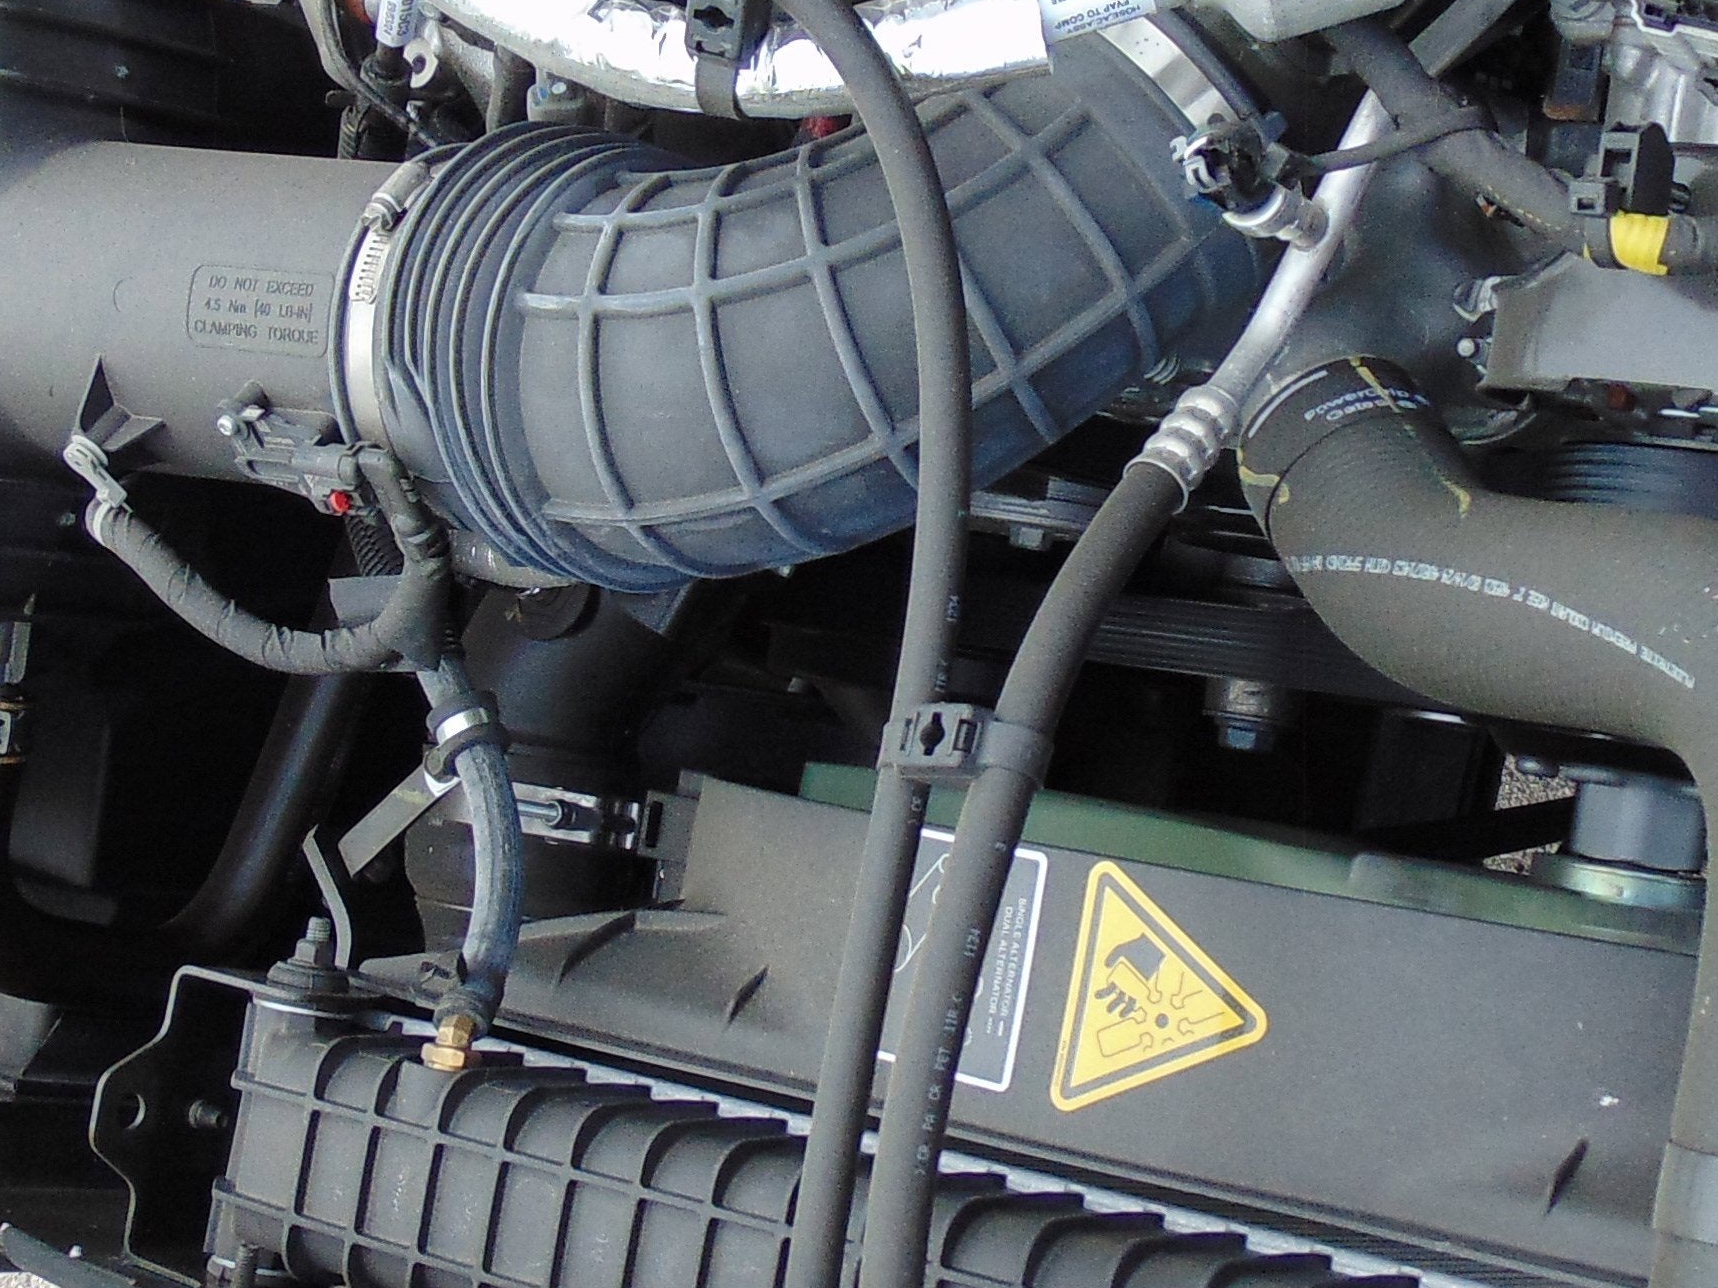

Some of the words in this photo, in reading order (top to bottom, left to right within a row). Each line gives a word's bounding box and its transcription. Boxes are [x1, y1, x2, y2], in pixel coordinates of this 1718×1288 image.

[1054, 13, 1084, 29] COMP
[1086, 8, 1100, 18] TO
[208, 274, 226, 289] DO
[233, 277, 259, 293] NOT
[265, 279, 314, 297] EXCEED
[193, 319, 257, 338] CLAMPING
[267, 326, 319, 344] TORQUE
[1001, 906, 1011, 935] DUAL
[988, 940, 1005, 1012] ALTERNATOR
[999, 943, 1018, 1015] ALTERNATOR
